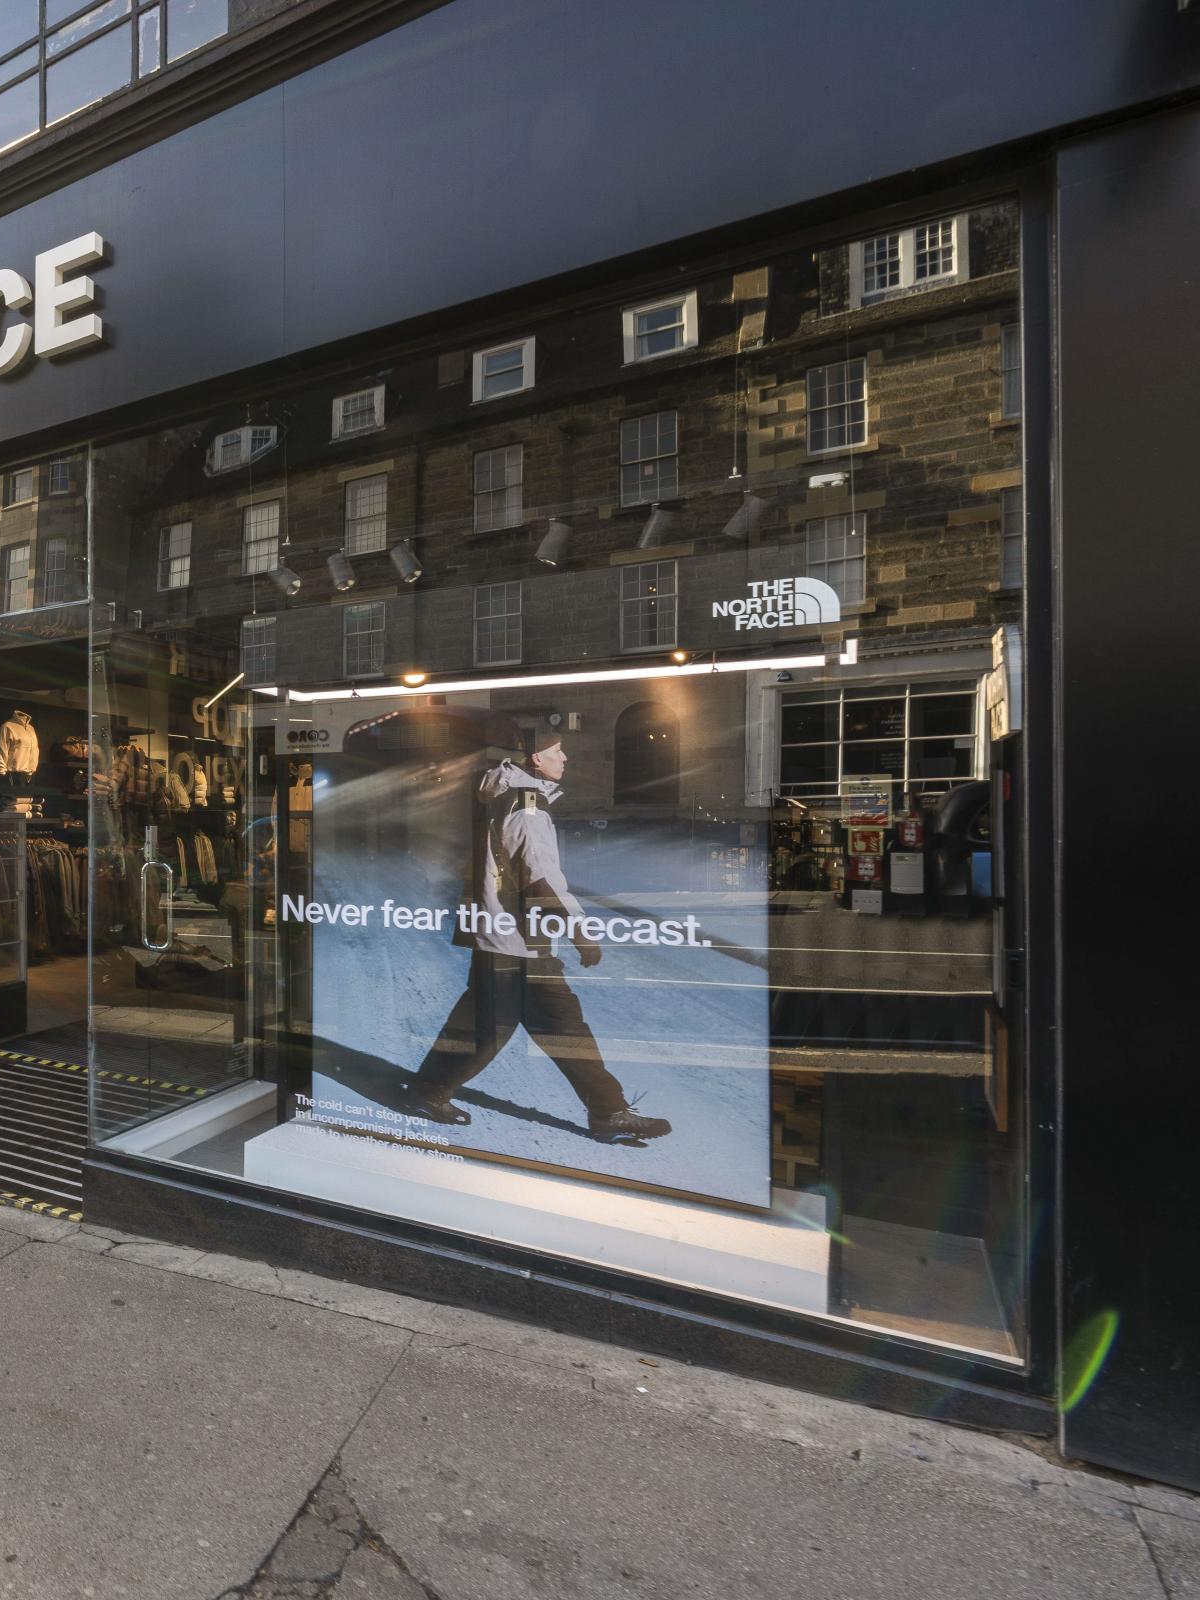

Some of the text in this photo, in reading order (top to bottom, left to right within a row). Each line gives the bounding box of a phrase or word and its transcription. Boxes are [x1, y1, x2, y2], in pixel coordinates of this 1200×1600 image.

[747, 577, 794, 598] THE
[712, 594, 794, 618] NORTH
[735, 610, 794, 631] FACE
[281, 893, 712, 948] Never fear the forecast.
[294, 1093, 428, 1127] The cold can't stop you
[295, 1107, 449, 1146] in uncompromising jackets
[427, 1147, 465, 1164] storm
